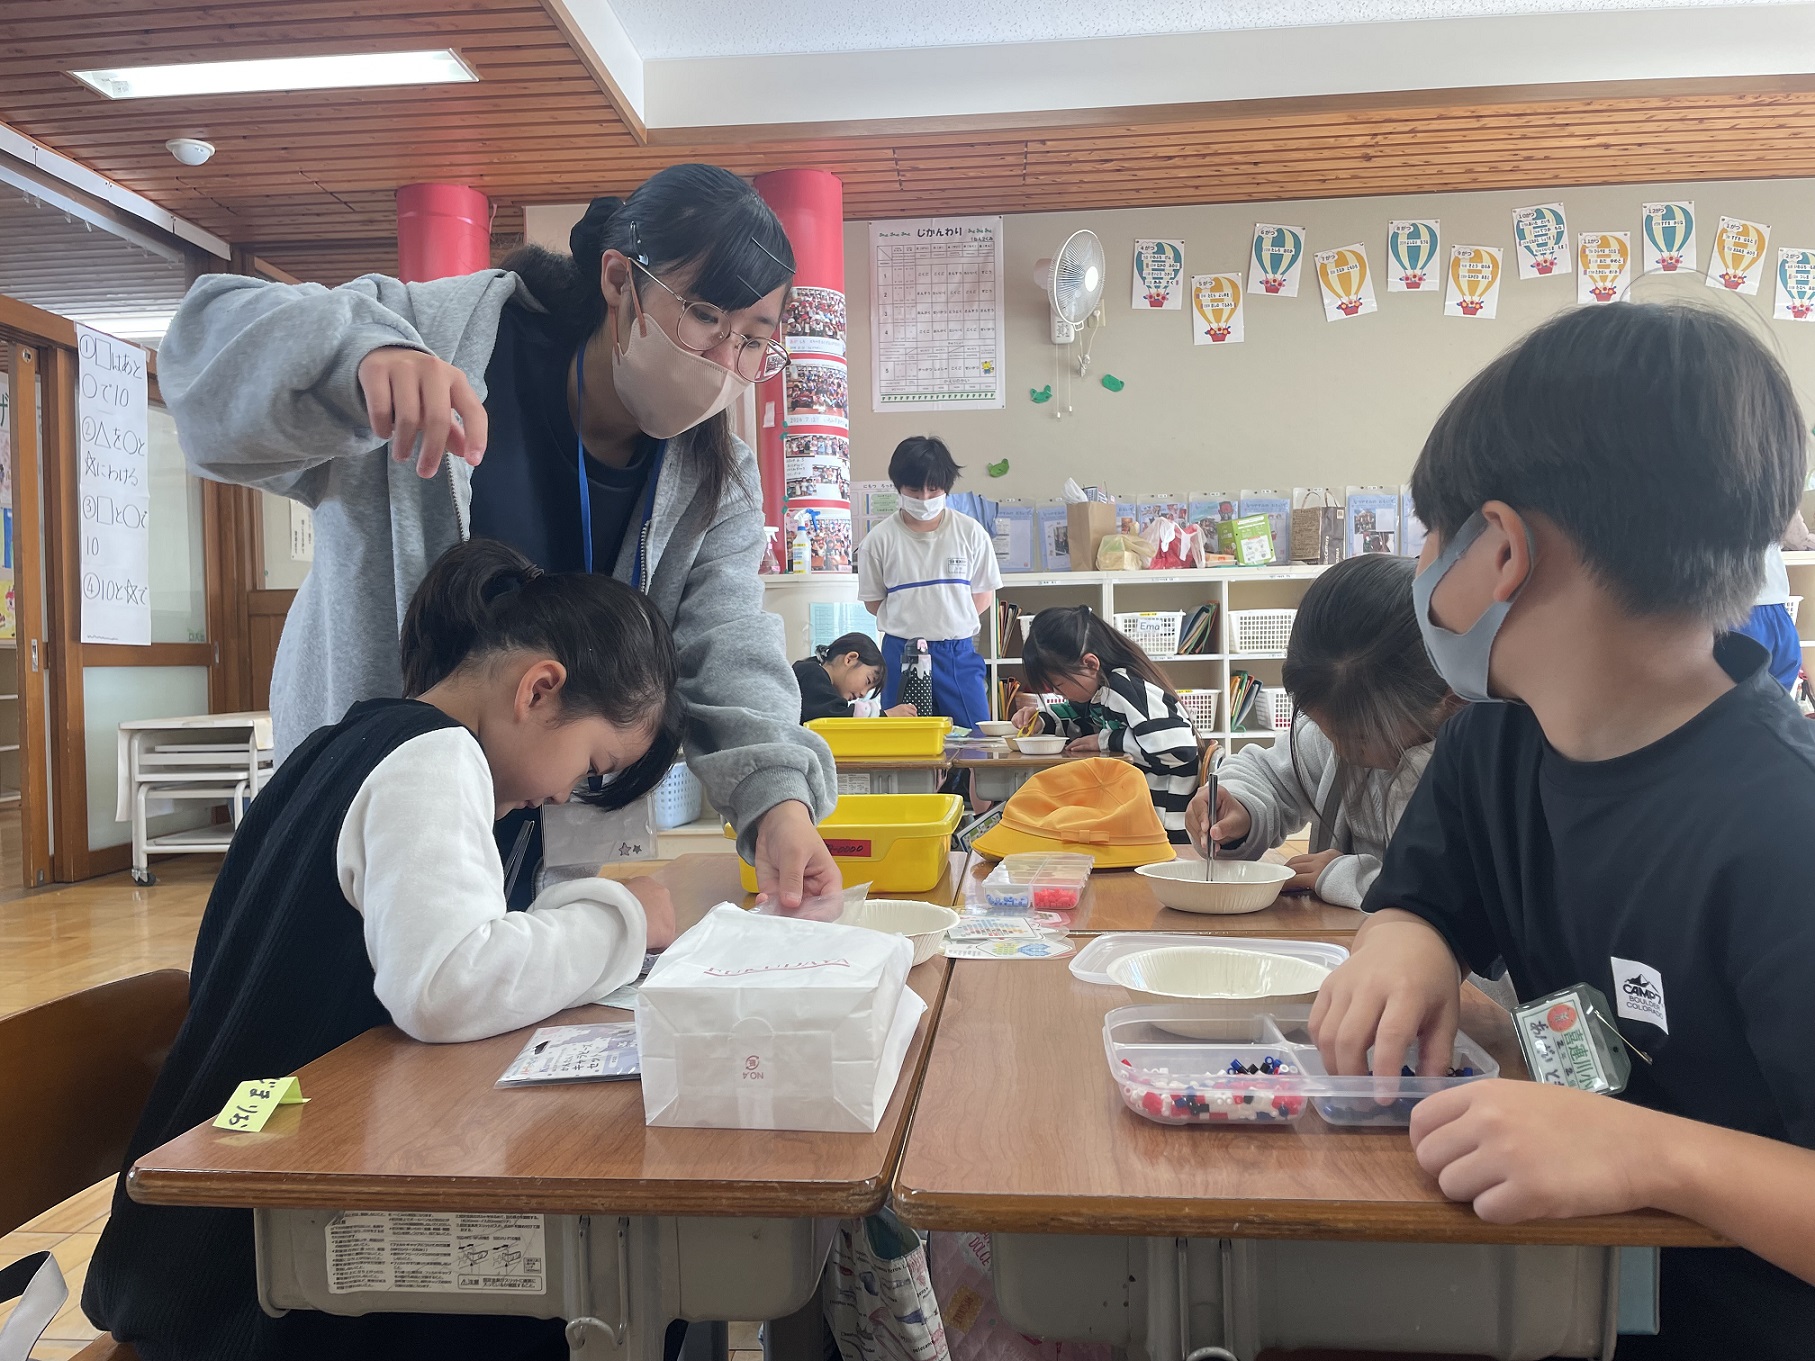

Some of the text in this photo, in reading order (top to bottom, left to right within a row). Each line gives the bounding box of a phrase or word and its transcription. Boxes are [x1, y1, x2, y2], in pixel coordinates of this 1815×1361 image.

[917, 227, 962, 238] じかんわり
[87, 536, 99, 556] 10
[1140, 622, 1161, 631] Ema
[1626, 1001, 1664, 1020] COLORADO
